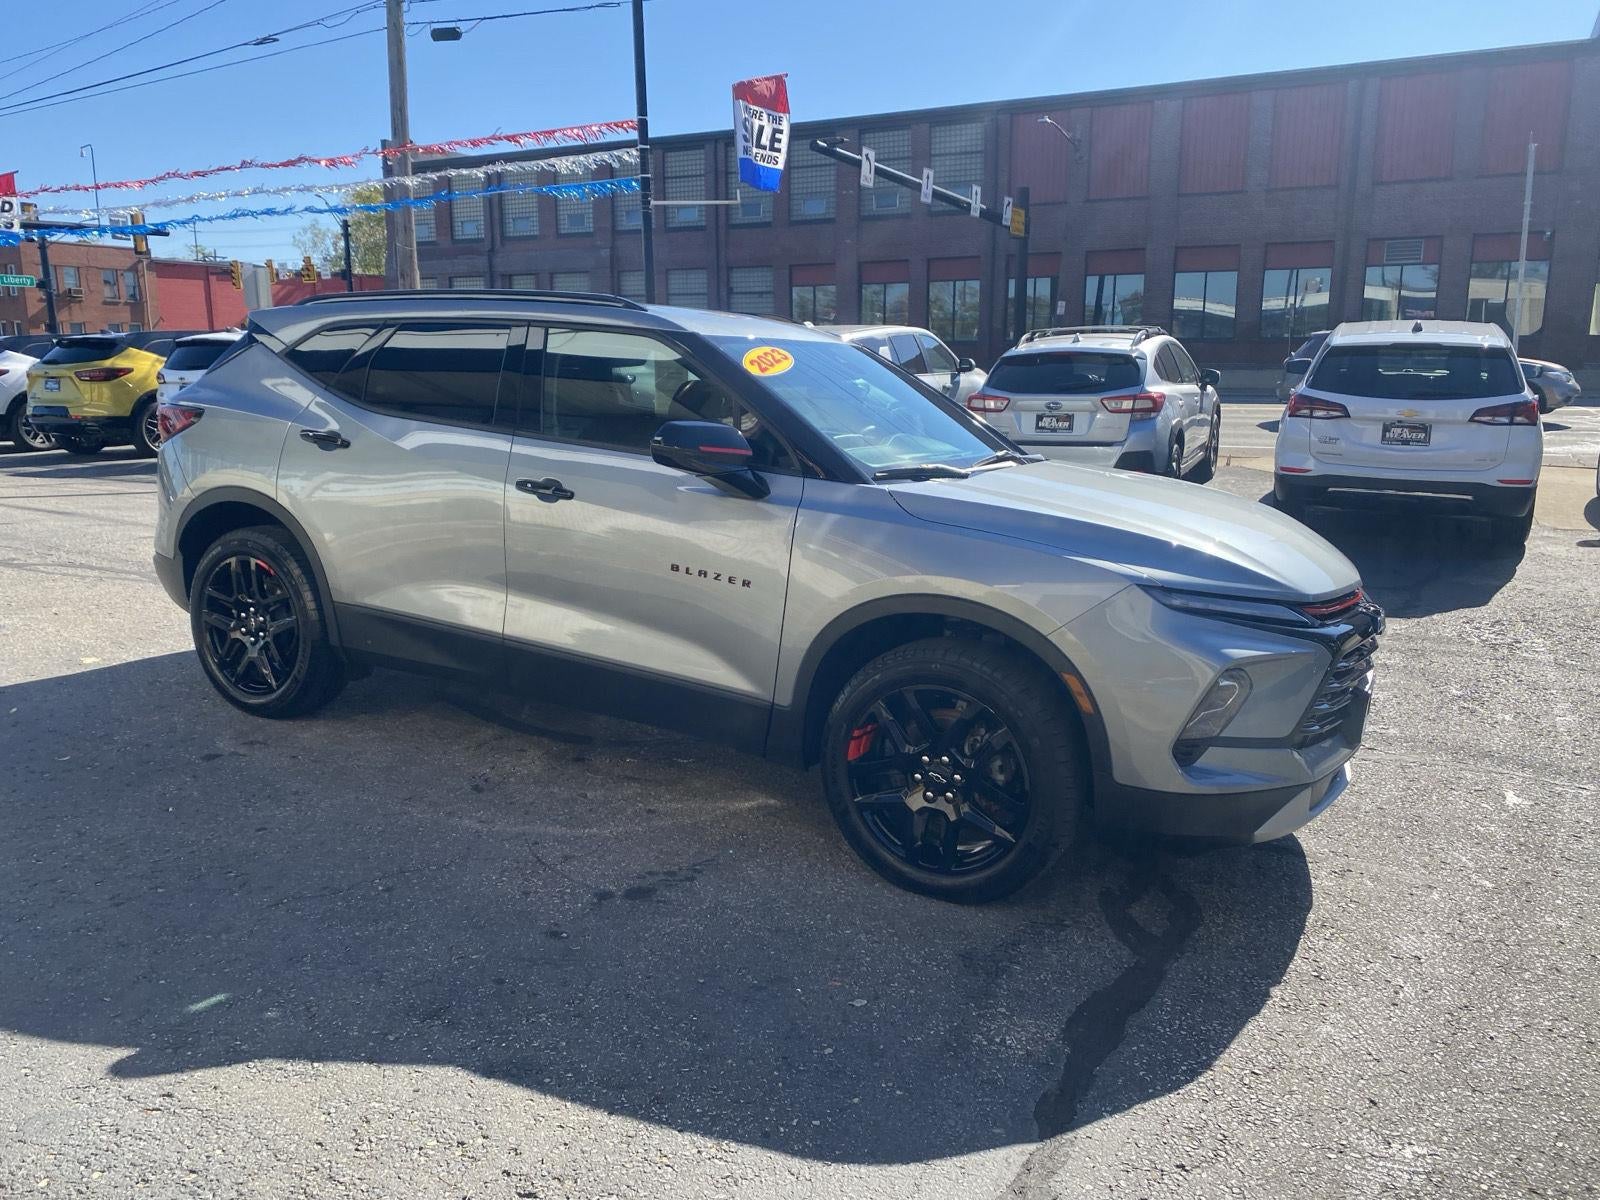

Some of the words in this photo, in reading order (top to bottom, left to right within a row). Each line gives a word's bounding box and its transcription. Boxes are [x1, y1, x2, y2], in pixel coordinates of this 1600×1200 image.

[767, 113, 784, 126] THE
[754, 152, 780, 166] ENDS
[3, 276, 31, 286] Liberty
[749, 348, 789, 374] 2023
[1385, 431, 1426, 439] WEAVER
[670, 563, 752, 589] BLAZER
